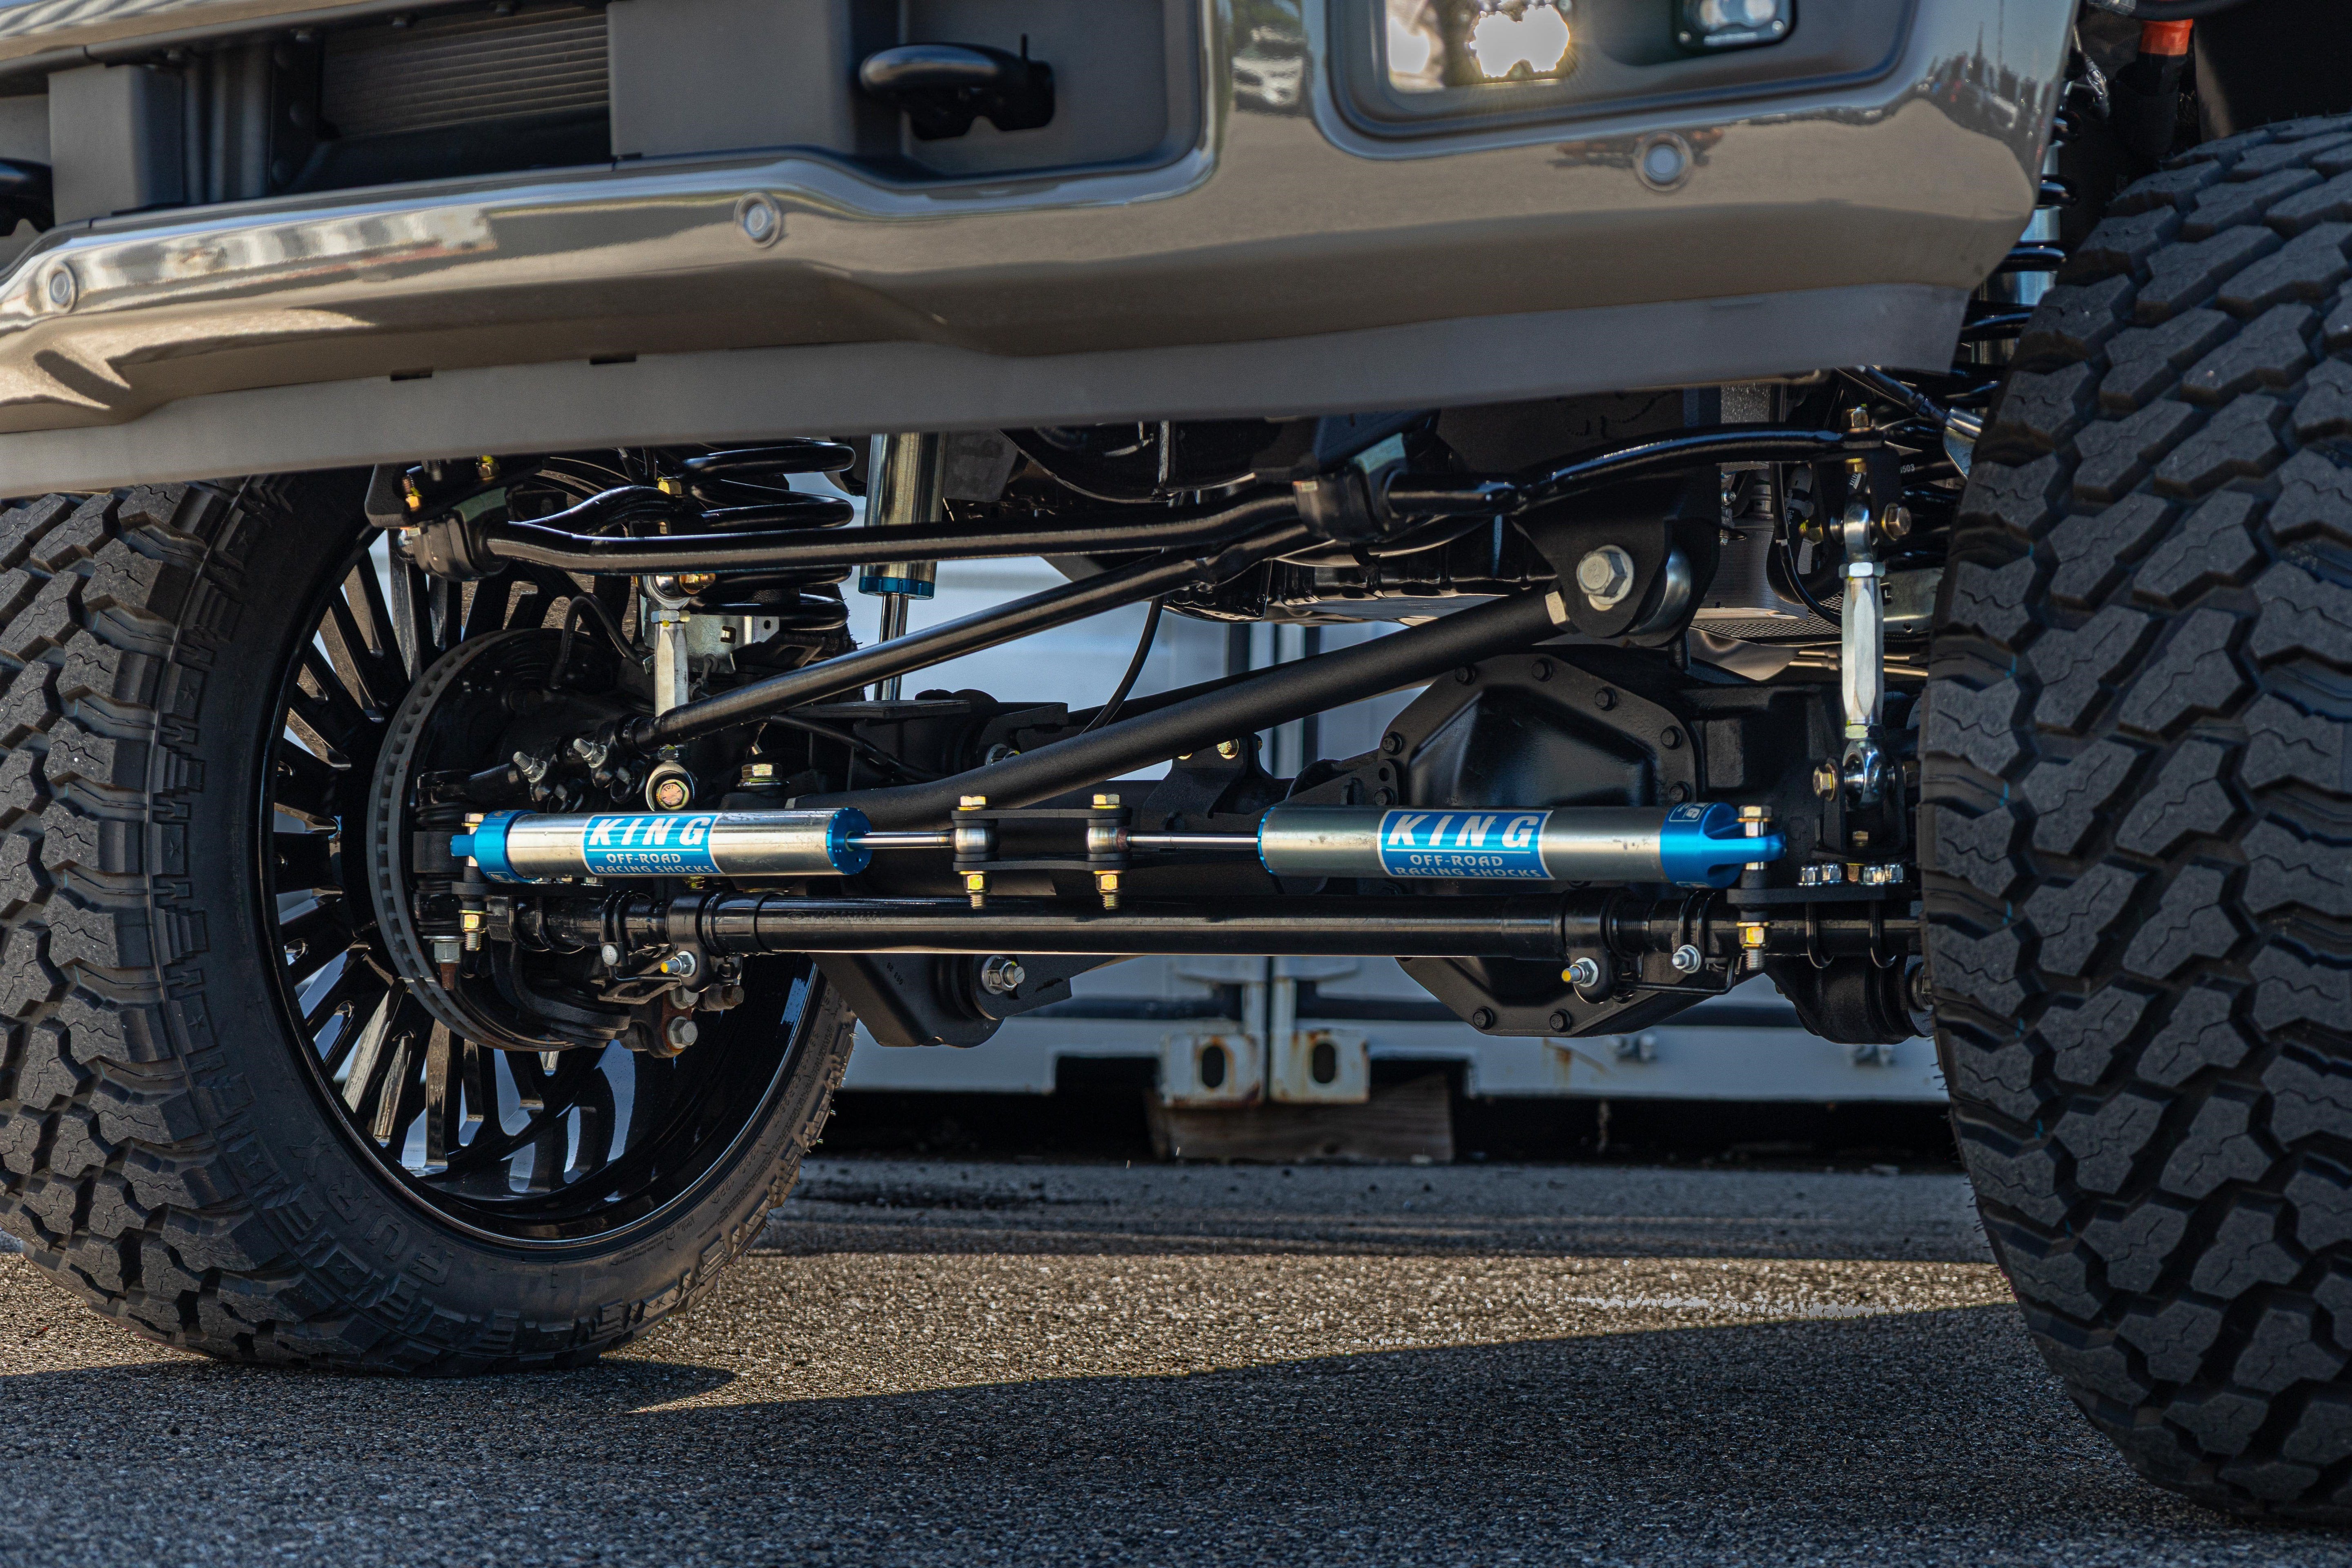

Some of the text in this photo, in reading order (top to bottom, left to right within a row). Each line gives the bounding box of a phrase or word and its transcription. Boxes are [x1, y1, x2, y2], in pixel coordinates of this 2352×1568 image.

[588, 817, 711, 845] KING
[1387, 815, 1539, 847] KING
[606, 853, 681, 864] OFF-ROAD
[1410, 854, 1503, 866] OFF-ROAD
[1394, 867, 1541, 878] RACING SHOCKS
[288, 1137, 454, 1287] FURY
